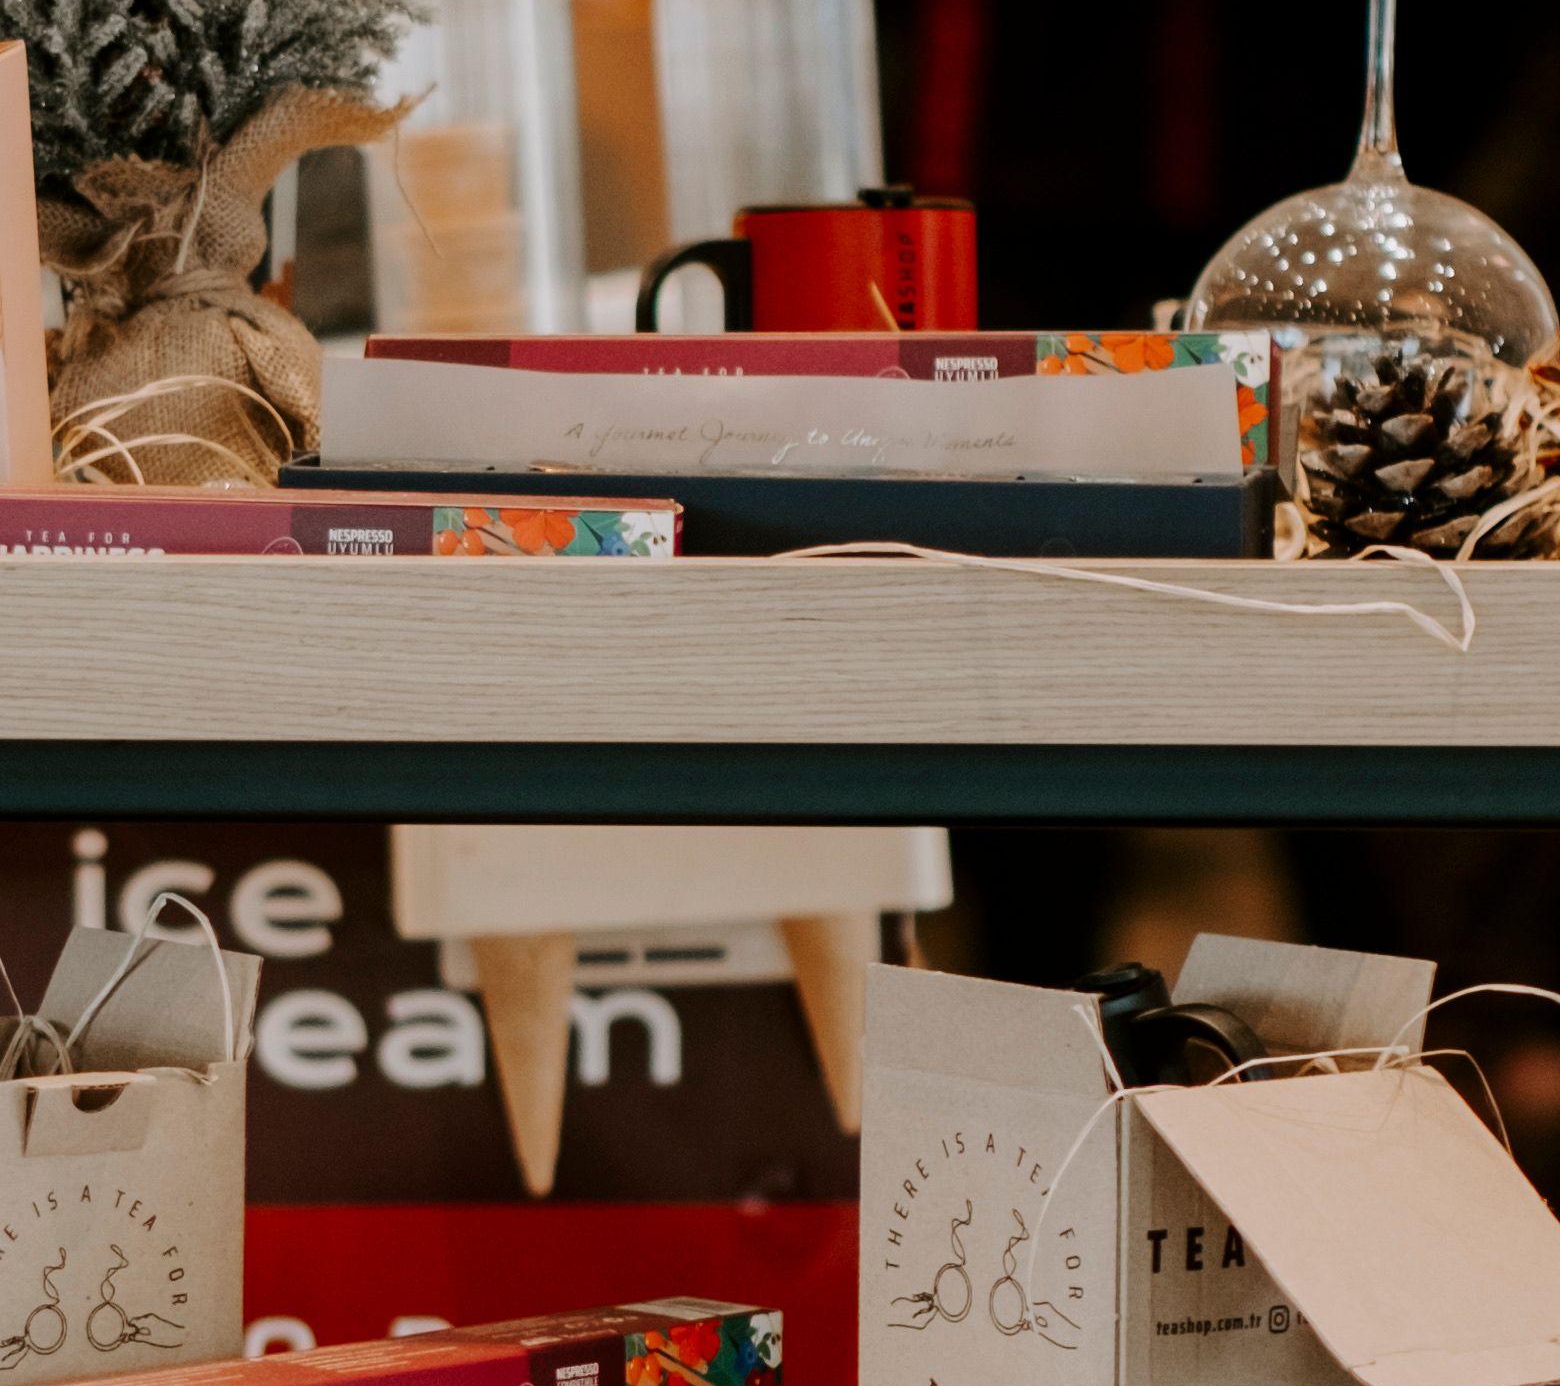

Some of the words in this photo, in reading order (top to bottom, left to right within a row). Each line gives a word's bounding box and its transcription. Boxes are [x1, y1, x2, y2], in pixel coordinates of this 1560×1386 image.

[898, 232, 917, 331] EASHOP
[934, 356, 999, 371] NESPRESSO
[563, 420, 586, 440] A
[806, 428, 832, 446] to
[26, 529, 68, 543] TEA
[88, 531, 132, 545] FOR
[327, 527, 394, 543] NESPRESSO
[72, 827, 345, 958] ice
[254, 986, 682, 1090] eam
[884, 1157, 930, 1271] THERE
[941, 1131, 966, 1159] IS
[984, 1132, 996, 1154] A
[1016, 1146, 1051, 1197] TE
[1058, 1226, 1084, 1300] FOR
[32, 1189, 60, 1218] IS
[80, 1184, 93, 1203] A
[112, 1187, 158, 1233] TEA
[160, 1243, 189, 1308] FOR
[1155, 1312, 1262, 1337] teashop.com.tr
[555, 1361, 600, 1382] NESPRESSO
